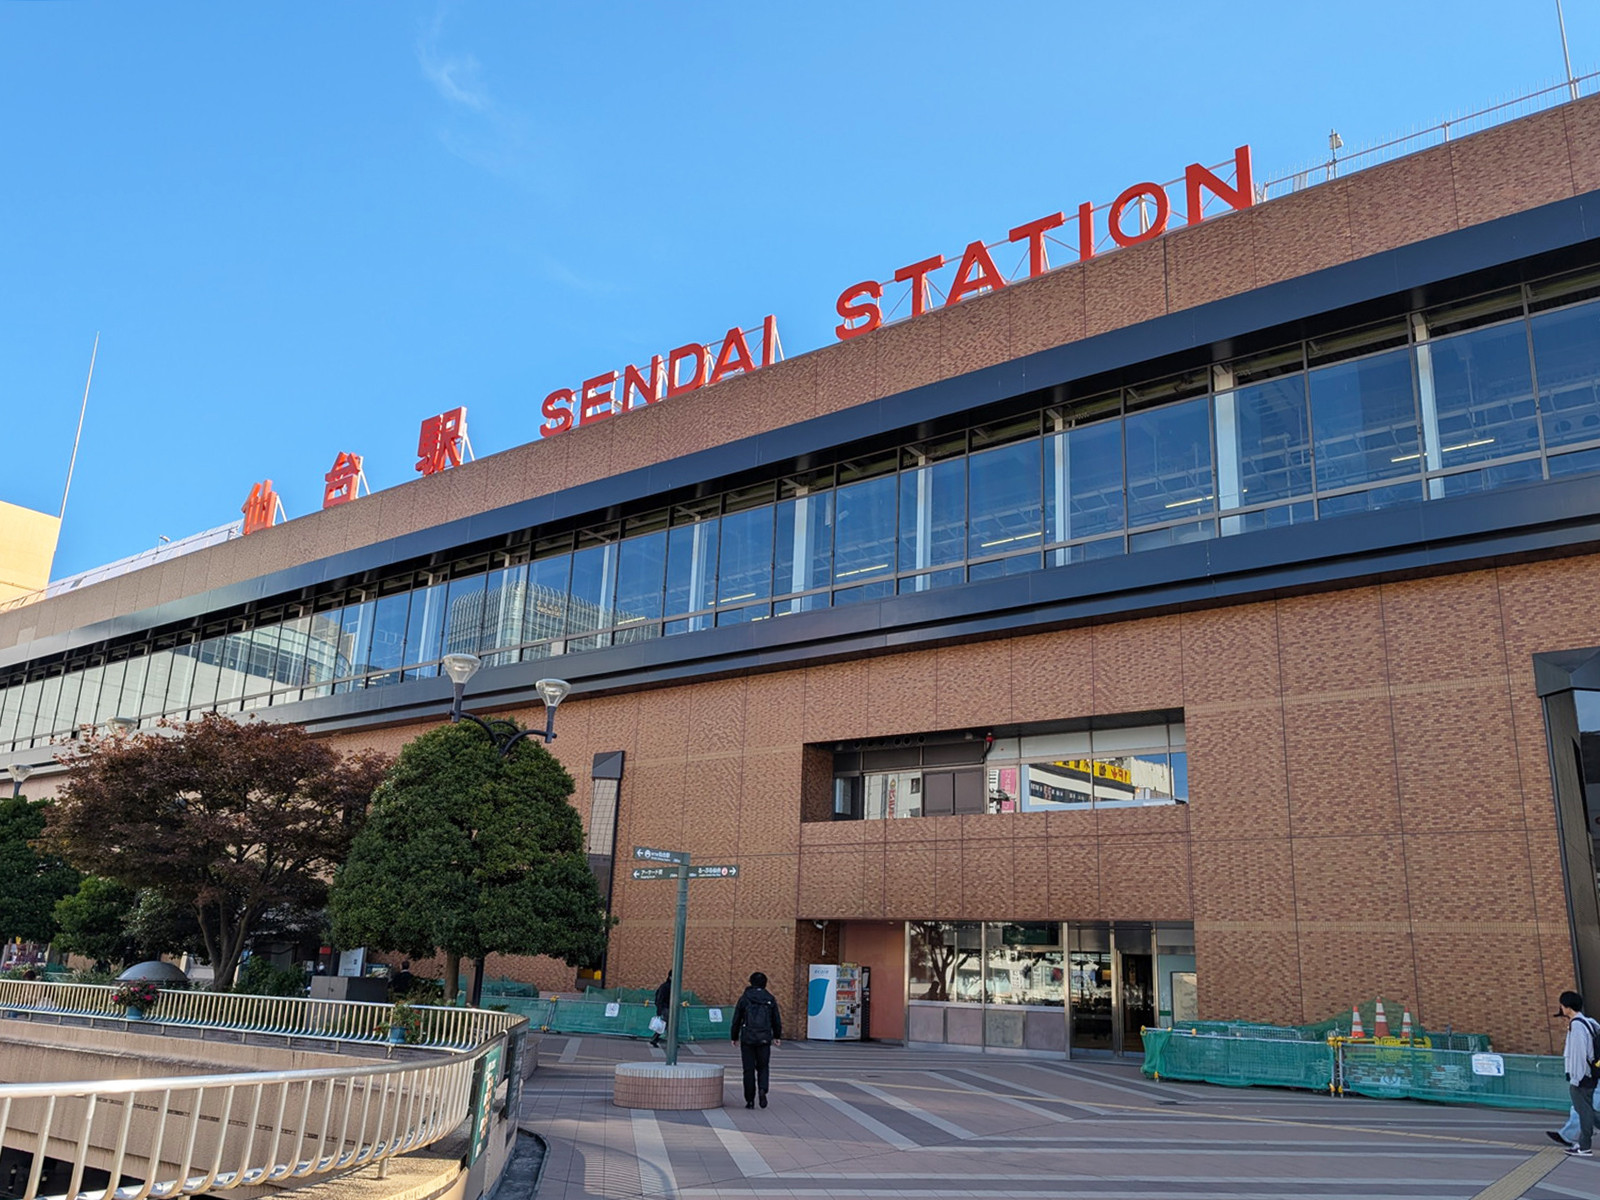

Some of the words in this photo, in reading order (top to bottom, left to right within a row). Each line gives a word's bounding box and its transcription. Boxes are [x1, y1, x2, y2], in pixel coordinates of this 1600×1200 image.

[540, 315, 774, 437] SENDAI
[836, 145, 1254, 341] STATION
[242, 406, 467, 535] 仙台駅
